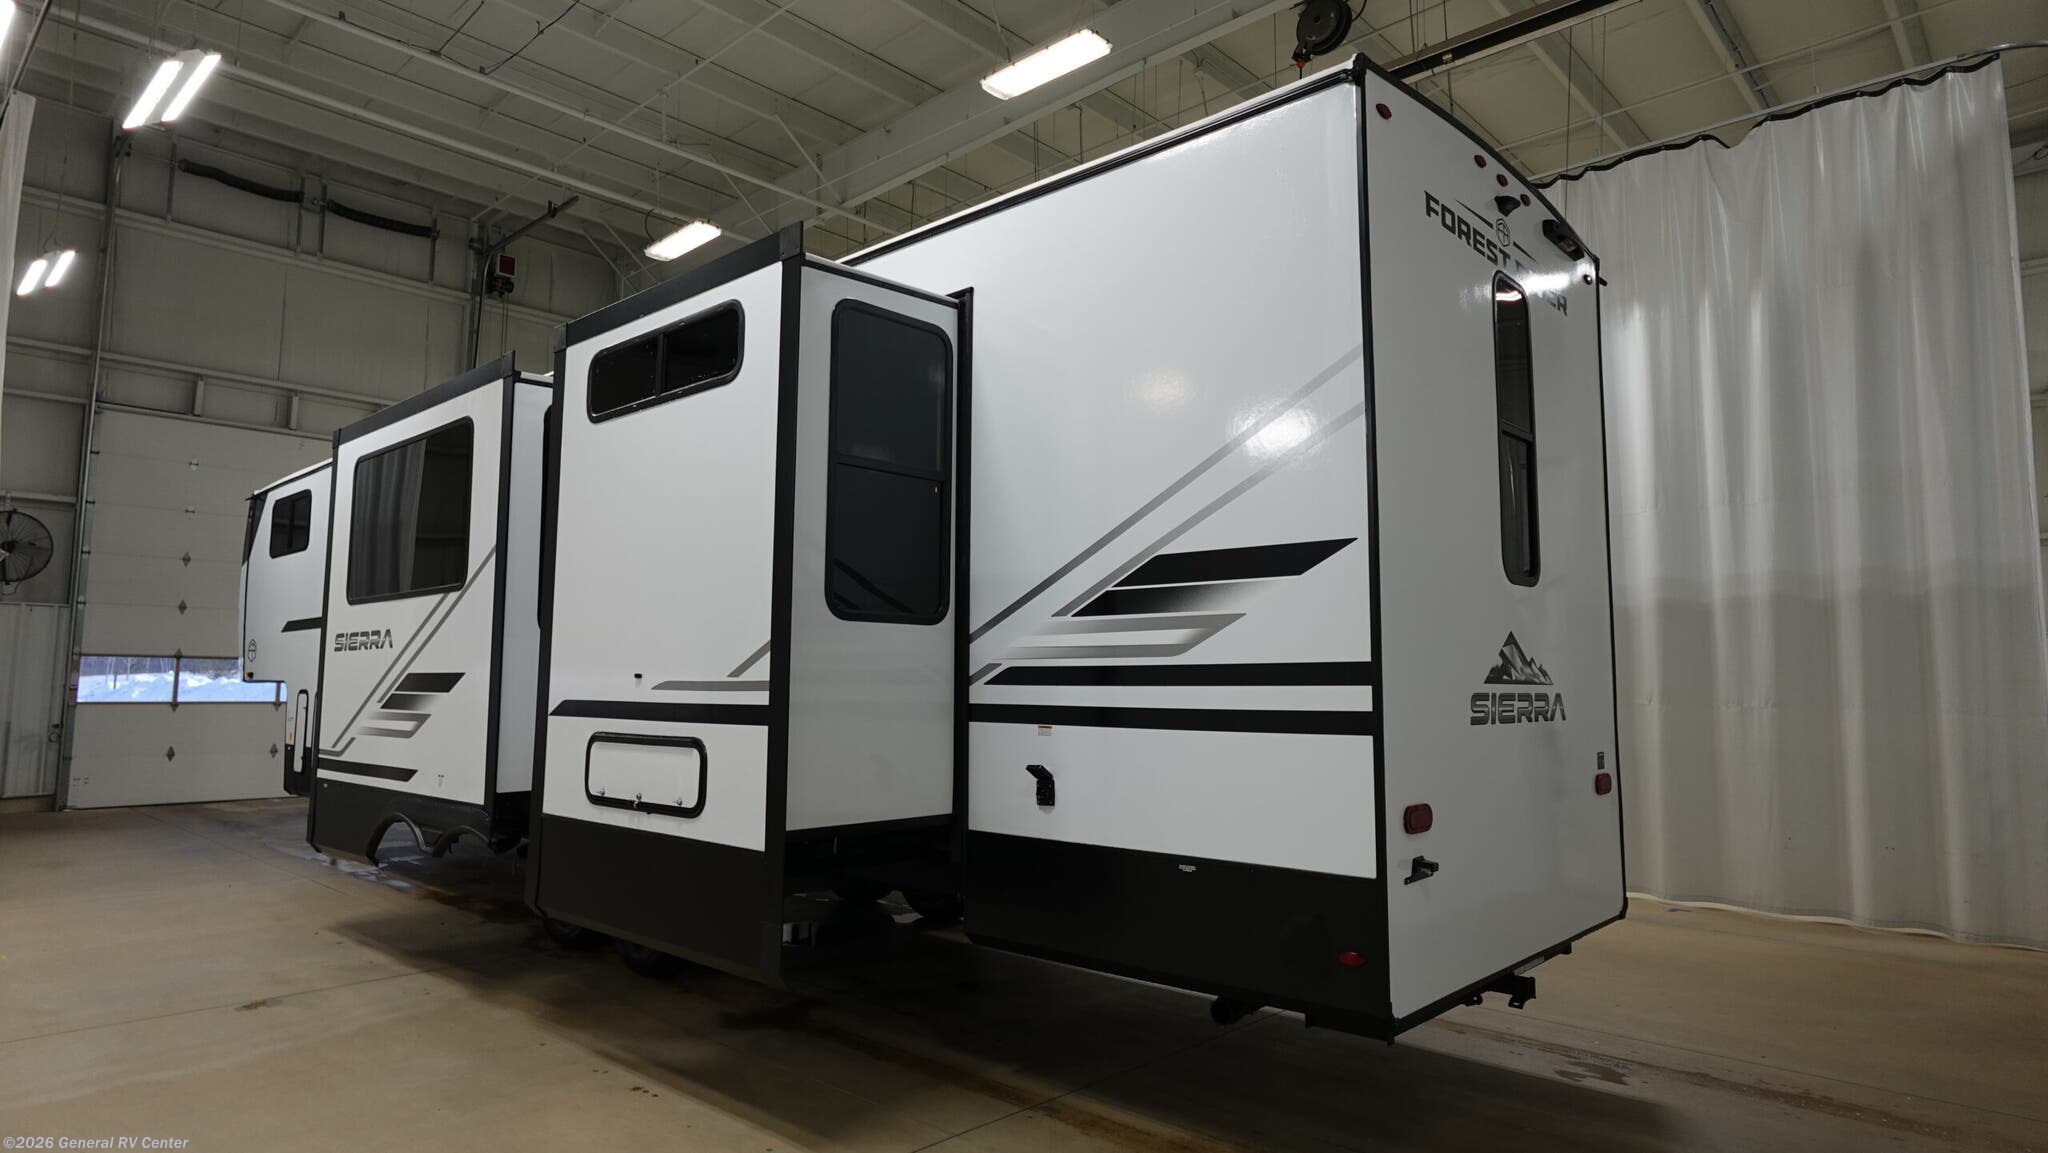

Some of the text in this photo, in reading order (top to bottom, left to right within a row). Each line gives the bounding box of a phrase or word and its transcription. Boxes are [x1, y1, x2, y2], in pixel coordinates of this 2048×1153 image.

[1424, 190, 1511, 267] FOREST
[334, 629, 393, 652] SIERRA
[1470, 692, 1566, 726] SIERRA
